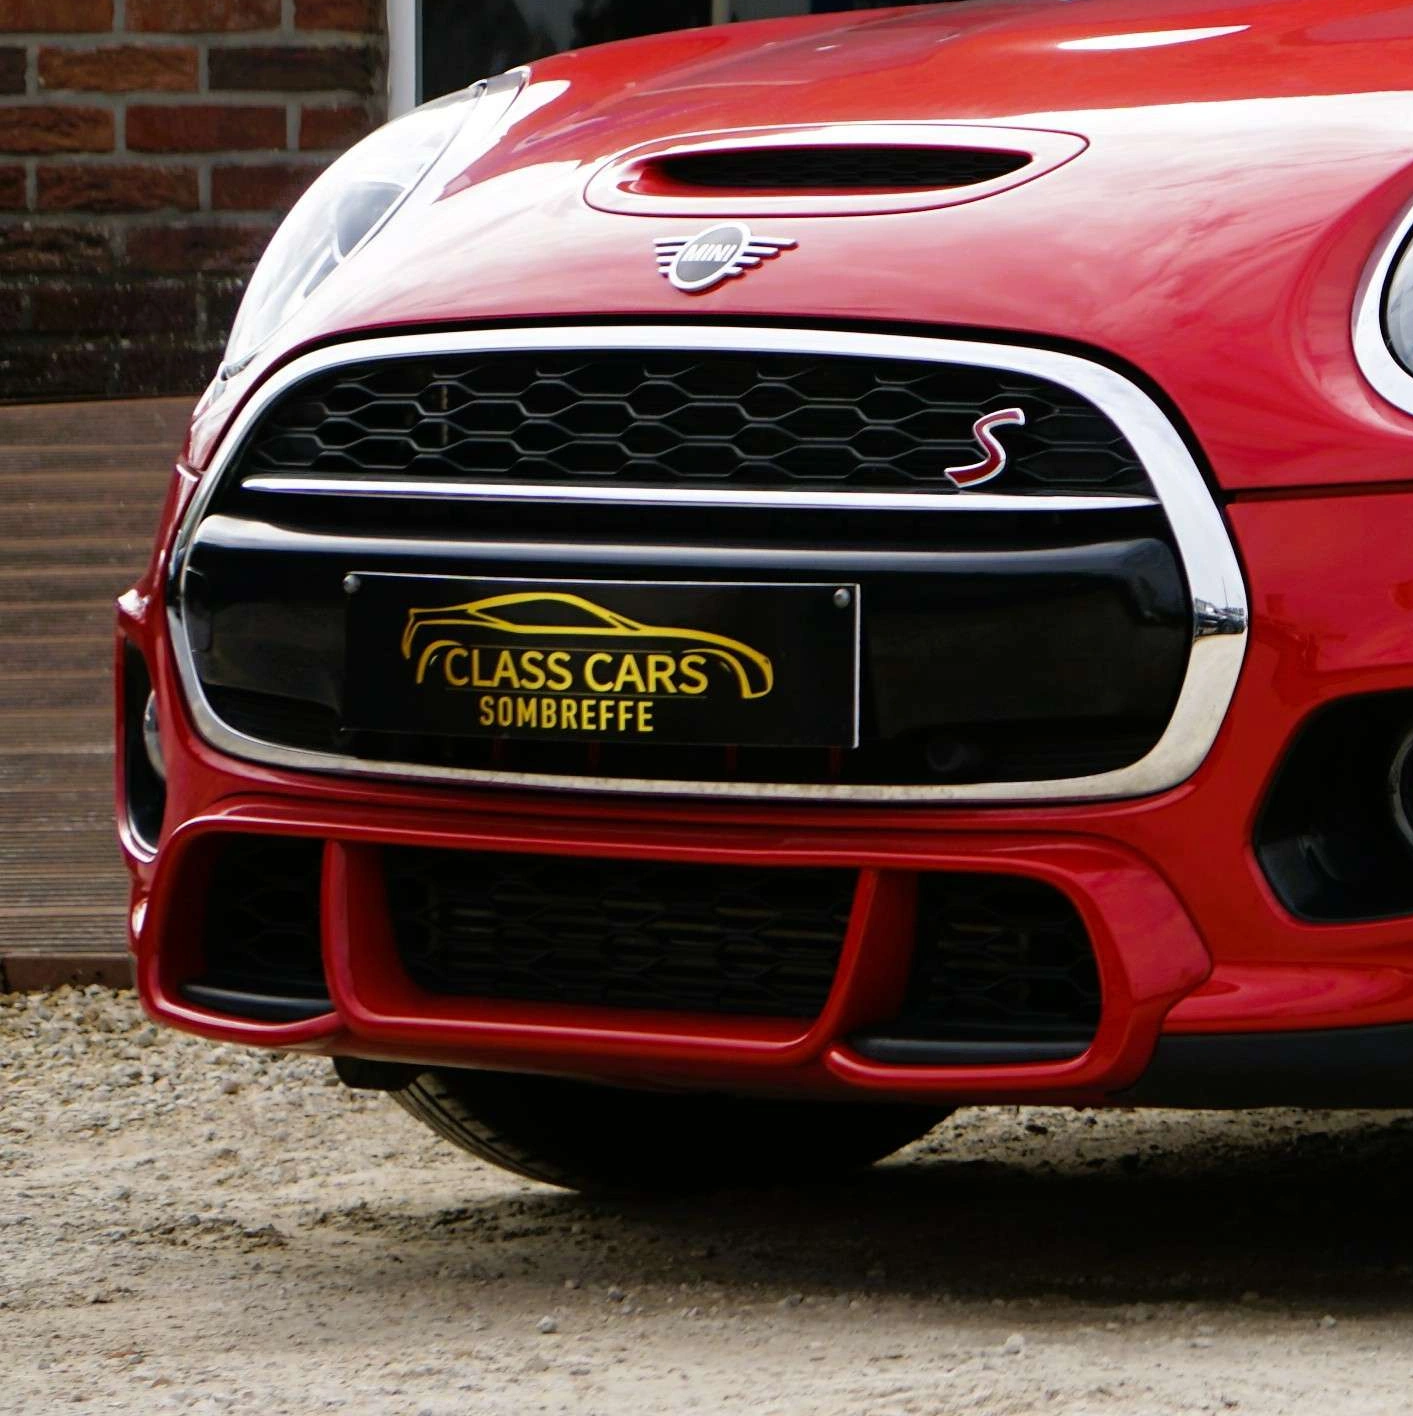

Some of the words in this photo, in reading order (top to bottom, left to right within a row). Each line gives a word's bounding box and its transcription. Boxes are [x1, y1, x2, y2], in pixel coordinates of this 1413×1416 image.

[680, 243, 738, 263] MINI
[944, 407, 1025, 488] S
[443, 649, 573, 691] CLASS
[584, 651, 709, 696] CARS
[479, 694, 654, 732] SOMBREFFE
